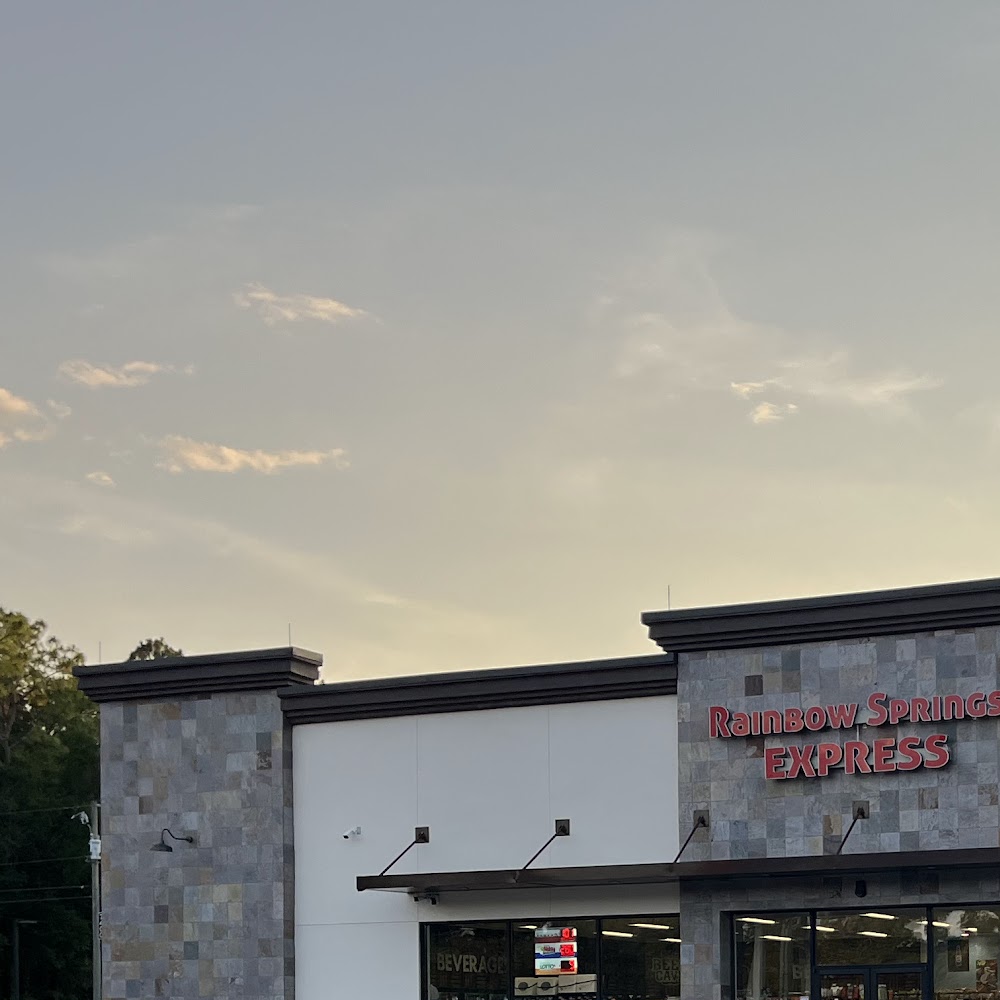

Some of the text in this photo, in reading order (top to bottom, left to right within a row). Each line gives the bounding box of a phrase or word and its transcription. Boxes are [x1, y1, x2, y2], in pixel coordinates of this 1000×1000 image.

[764, 734, 950, 780] EXPRESS
[652, 957, 679, 971] BEE
[655, 970, 679, 983] CAV
